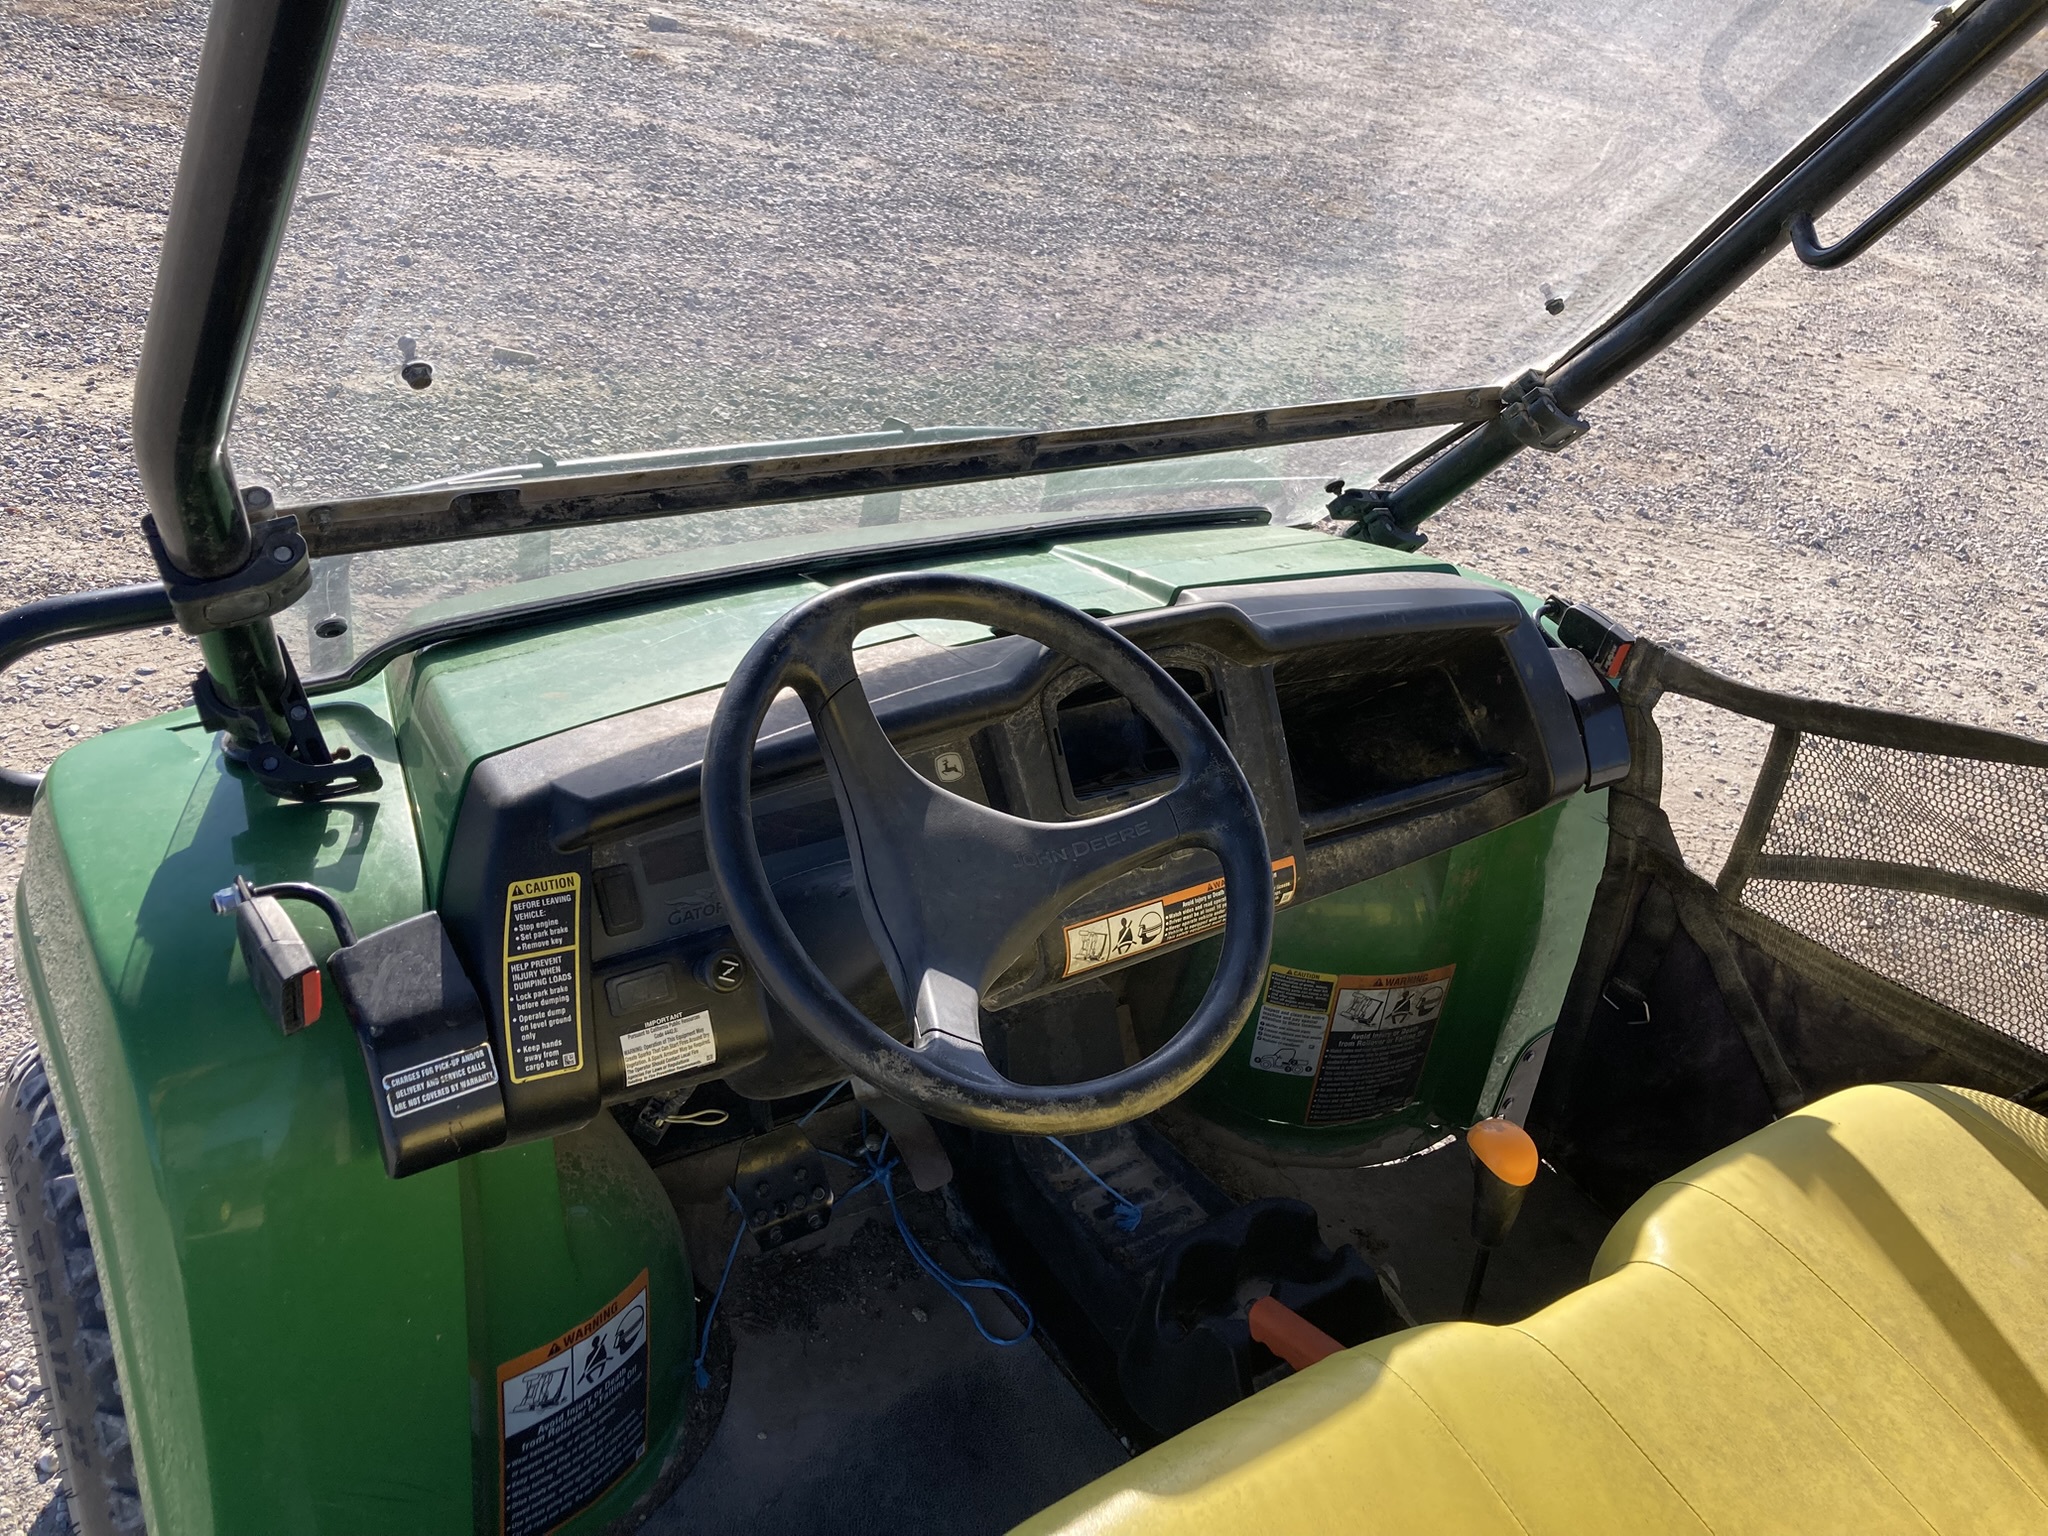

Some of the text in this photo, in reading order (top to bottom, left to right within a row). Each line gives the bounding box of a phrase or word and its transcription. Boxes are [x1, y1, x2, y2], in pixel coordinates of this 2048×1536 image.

[1013, 821, 1150, 868] JOHN DEERE
[526, 876, 574, 894] CAUTION
[513, 894, 572, 911] BEFORE LEAVING
[1182, 899, 1194, 908] Avoid
[1194, 896, 1207, 904] Injury
[514, 910, 546, 921] VEHICLE:
[519, 919, 559, 932] Stop engine
[520, 926, 568, 941] Set park brake
[522, 940, 550, 950] Remove
[511, 956, 562, 972] HELP PREVENT
[512, 966, 561, 982] INJURY WHEN
[513, 972, 572, 990] DUMPING LOADS
[1293, 970, 1320, 980] CAUTION
[1385, 974, 1429, 986] WARNING
[515, 985, 568, 1001] Lock park brake
[517, 995, 570, 1010] before dumping
[518, 1008, 566, 1023] Operate dump
[530, 1020, 547, 1030] level
[549, 1014, 572, 1027] ground
[644, 1012, 683, 1028] IMPORTANT
[521, 1032, 536, 1041] only
[628, 1031, 645, 1039] Pursuant
[650, 1024, 668, 1033] California
[523, 1039, 562, 1054] Keep hands
[644, 1040, 662, 1050] Operation
[676, 1031, 695, 1040] Equipment
[689, 1036, 702, 1044] Around
[524, 1050, 559, 1062] away from
[668, 1059, 689, 1068] Regulations
[391, 1050, 484, 1087] CHARGES FOR PICK-UP AND/OR
[525, 1059, 559, 1072] cargo box
[634, 1064, 651, 1072] Operator
[395, 1061, 486, 1099] DELIVERY AND SERVICE CALLS
[394, 1071, 493, 1113] ARE NOT COVERED BY WARRANTY
[4, 1134, 30, 1216] ALL
[28, 1230, 73, 1400] TRAIL
[564, 1302, 618, 1346] WARNING
[538, 1412, 564, 1435] Avoid
[567, 1396, 592, 1416] Injury
[594, 1388, 602, 1398] or
[605, 1368, 626, 1388] Death
[522, 1435, 545, 1451] from
[548, 1408, 586, 1438] Rollover
[588, 1401, 596, 1411] or
[600, 1377, 625, 1403] Falling
